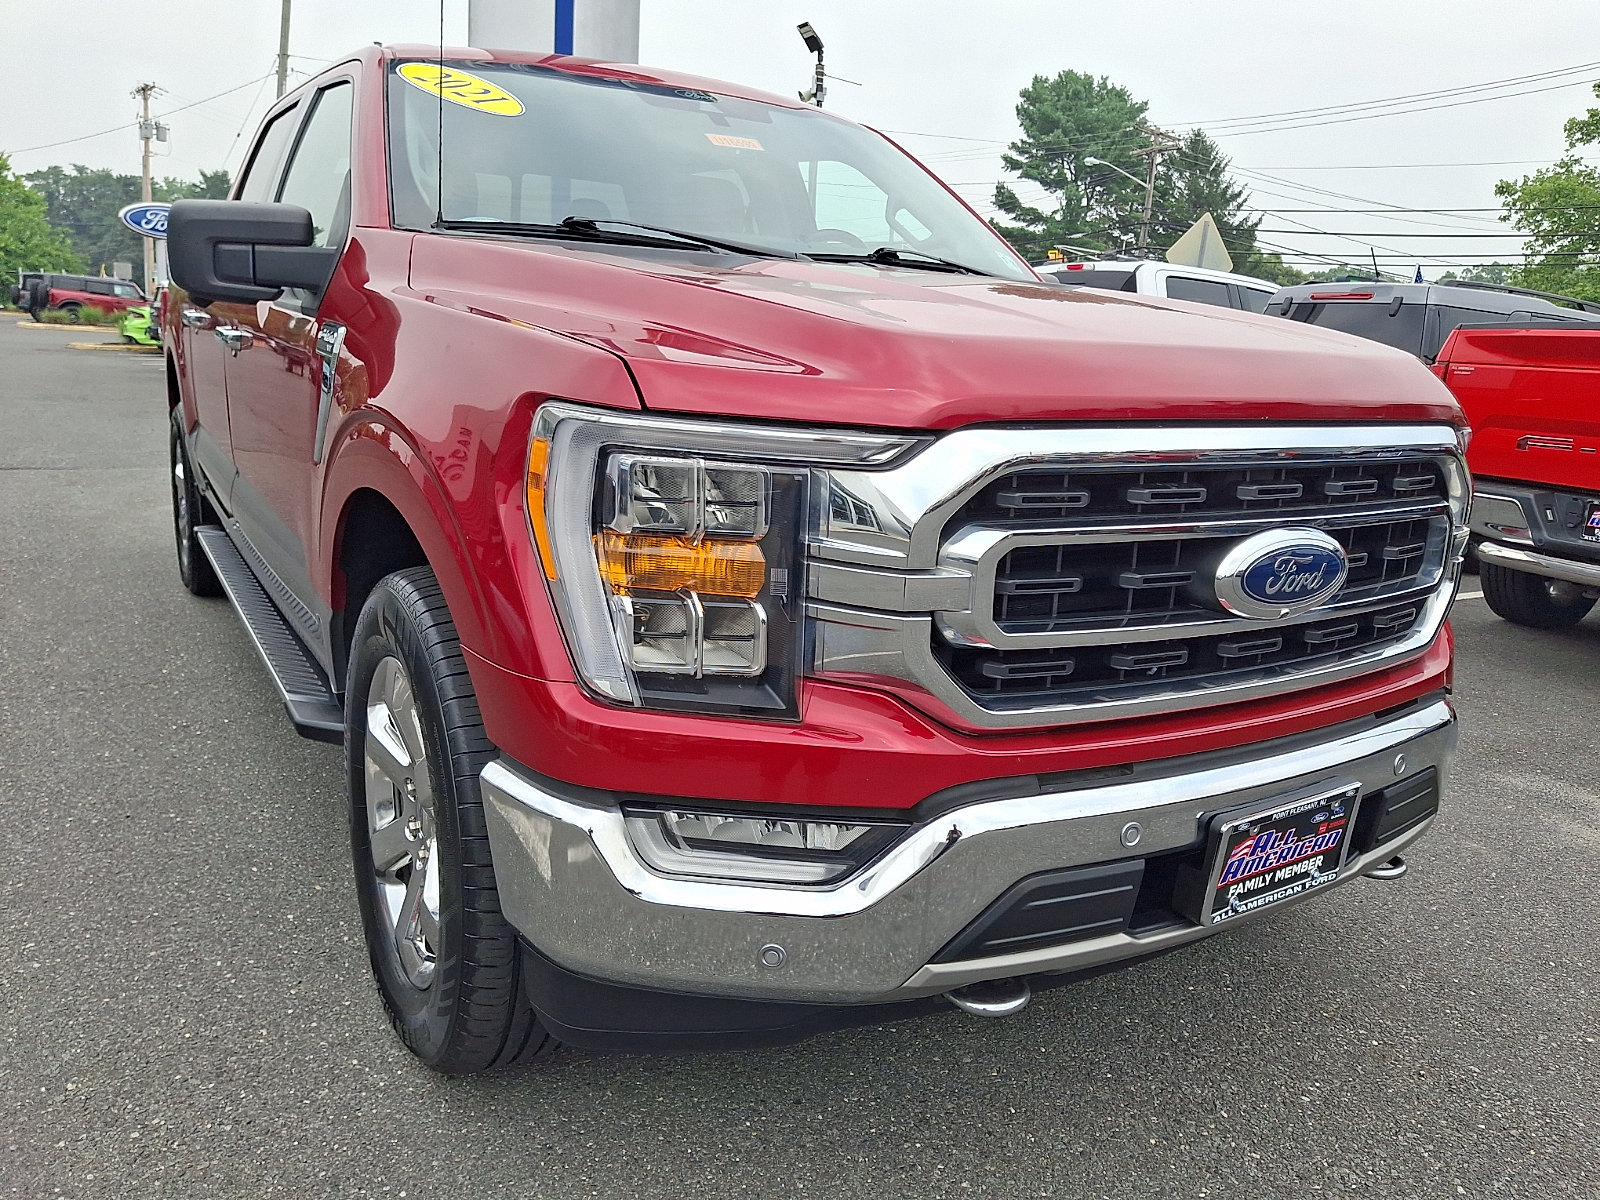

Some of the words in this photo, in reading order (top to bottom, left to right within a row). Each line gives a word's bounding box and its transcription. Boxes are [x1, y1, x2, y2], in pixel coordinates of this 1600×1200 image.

[412, 73, 509, 104] 2021
[141, 209, 168, 232] Fo
[1265, 556, 1327, 595] Ford
[1272, 810, 1290, 821] POINT
[1219, 829, 1342, 885] AMERICAN
[1249, 828, 1296, 857] ALL
[1228, 872, 1274, 898] FAMILY
[1275, 855, 1324, 881] MEMBER
[1213, 910, 1236, 924] ALL
[1238, 885, 1302, 912] AMERICAN
[1306, 873, 1337, 891] FORD
